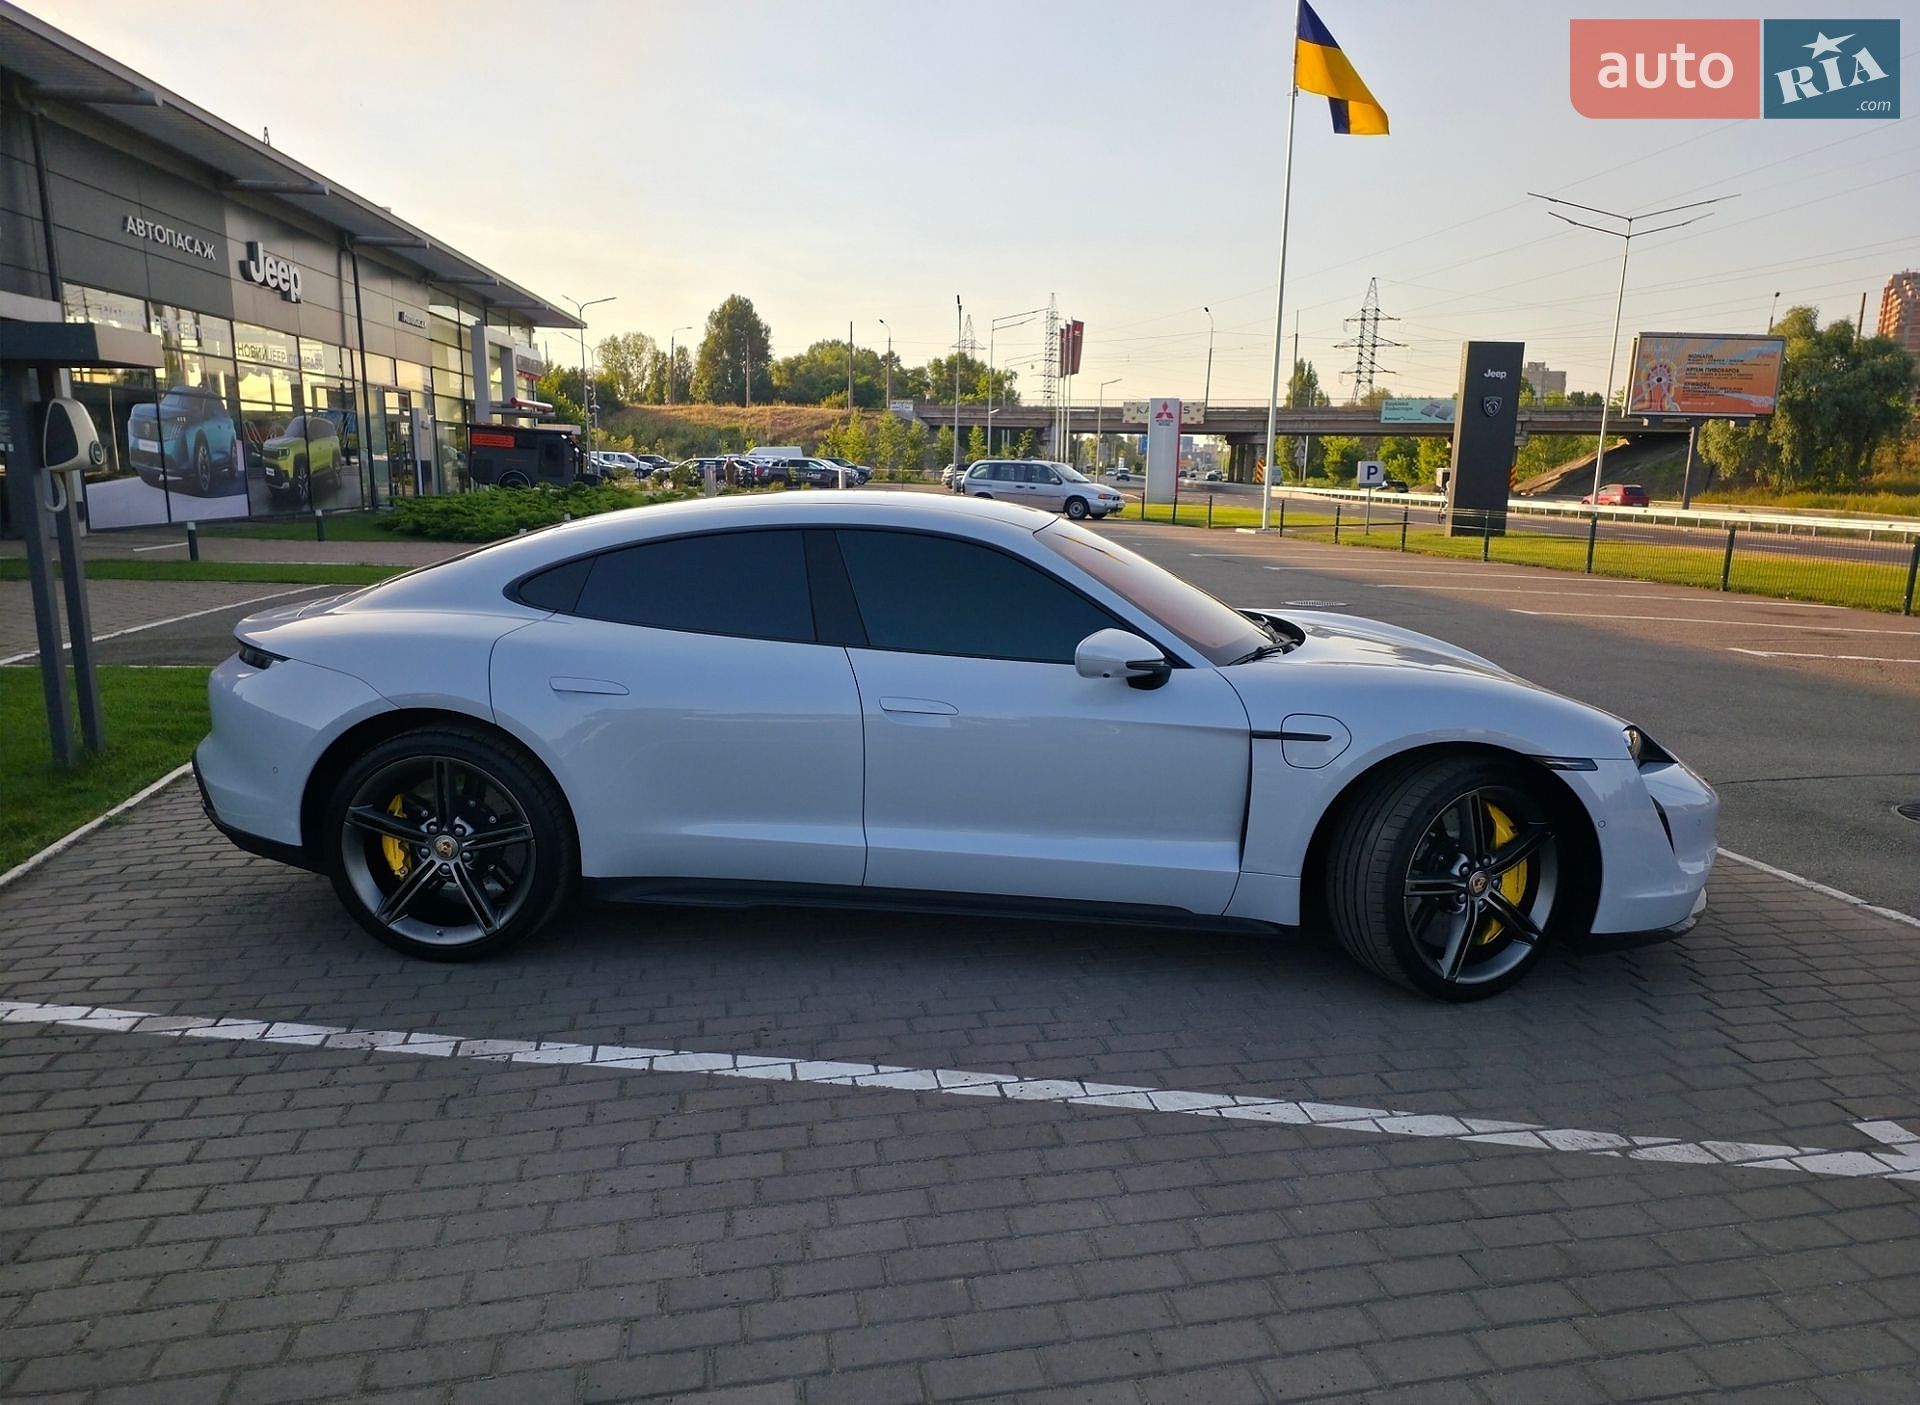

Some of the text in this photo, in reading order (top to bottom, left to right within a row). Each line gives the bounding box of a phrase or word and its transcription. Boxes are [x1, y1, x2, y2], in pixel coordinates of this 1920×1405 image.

[126, 215, 217, 261] АВТОПАСАЖ
[248, 241, 303, 303] Jeep
[1483, 368, 1507, 380] Jeep
[1366, 465, 1378, 480] P
